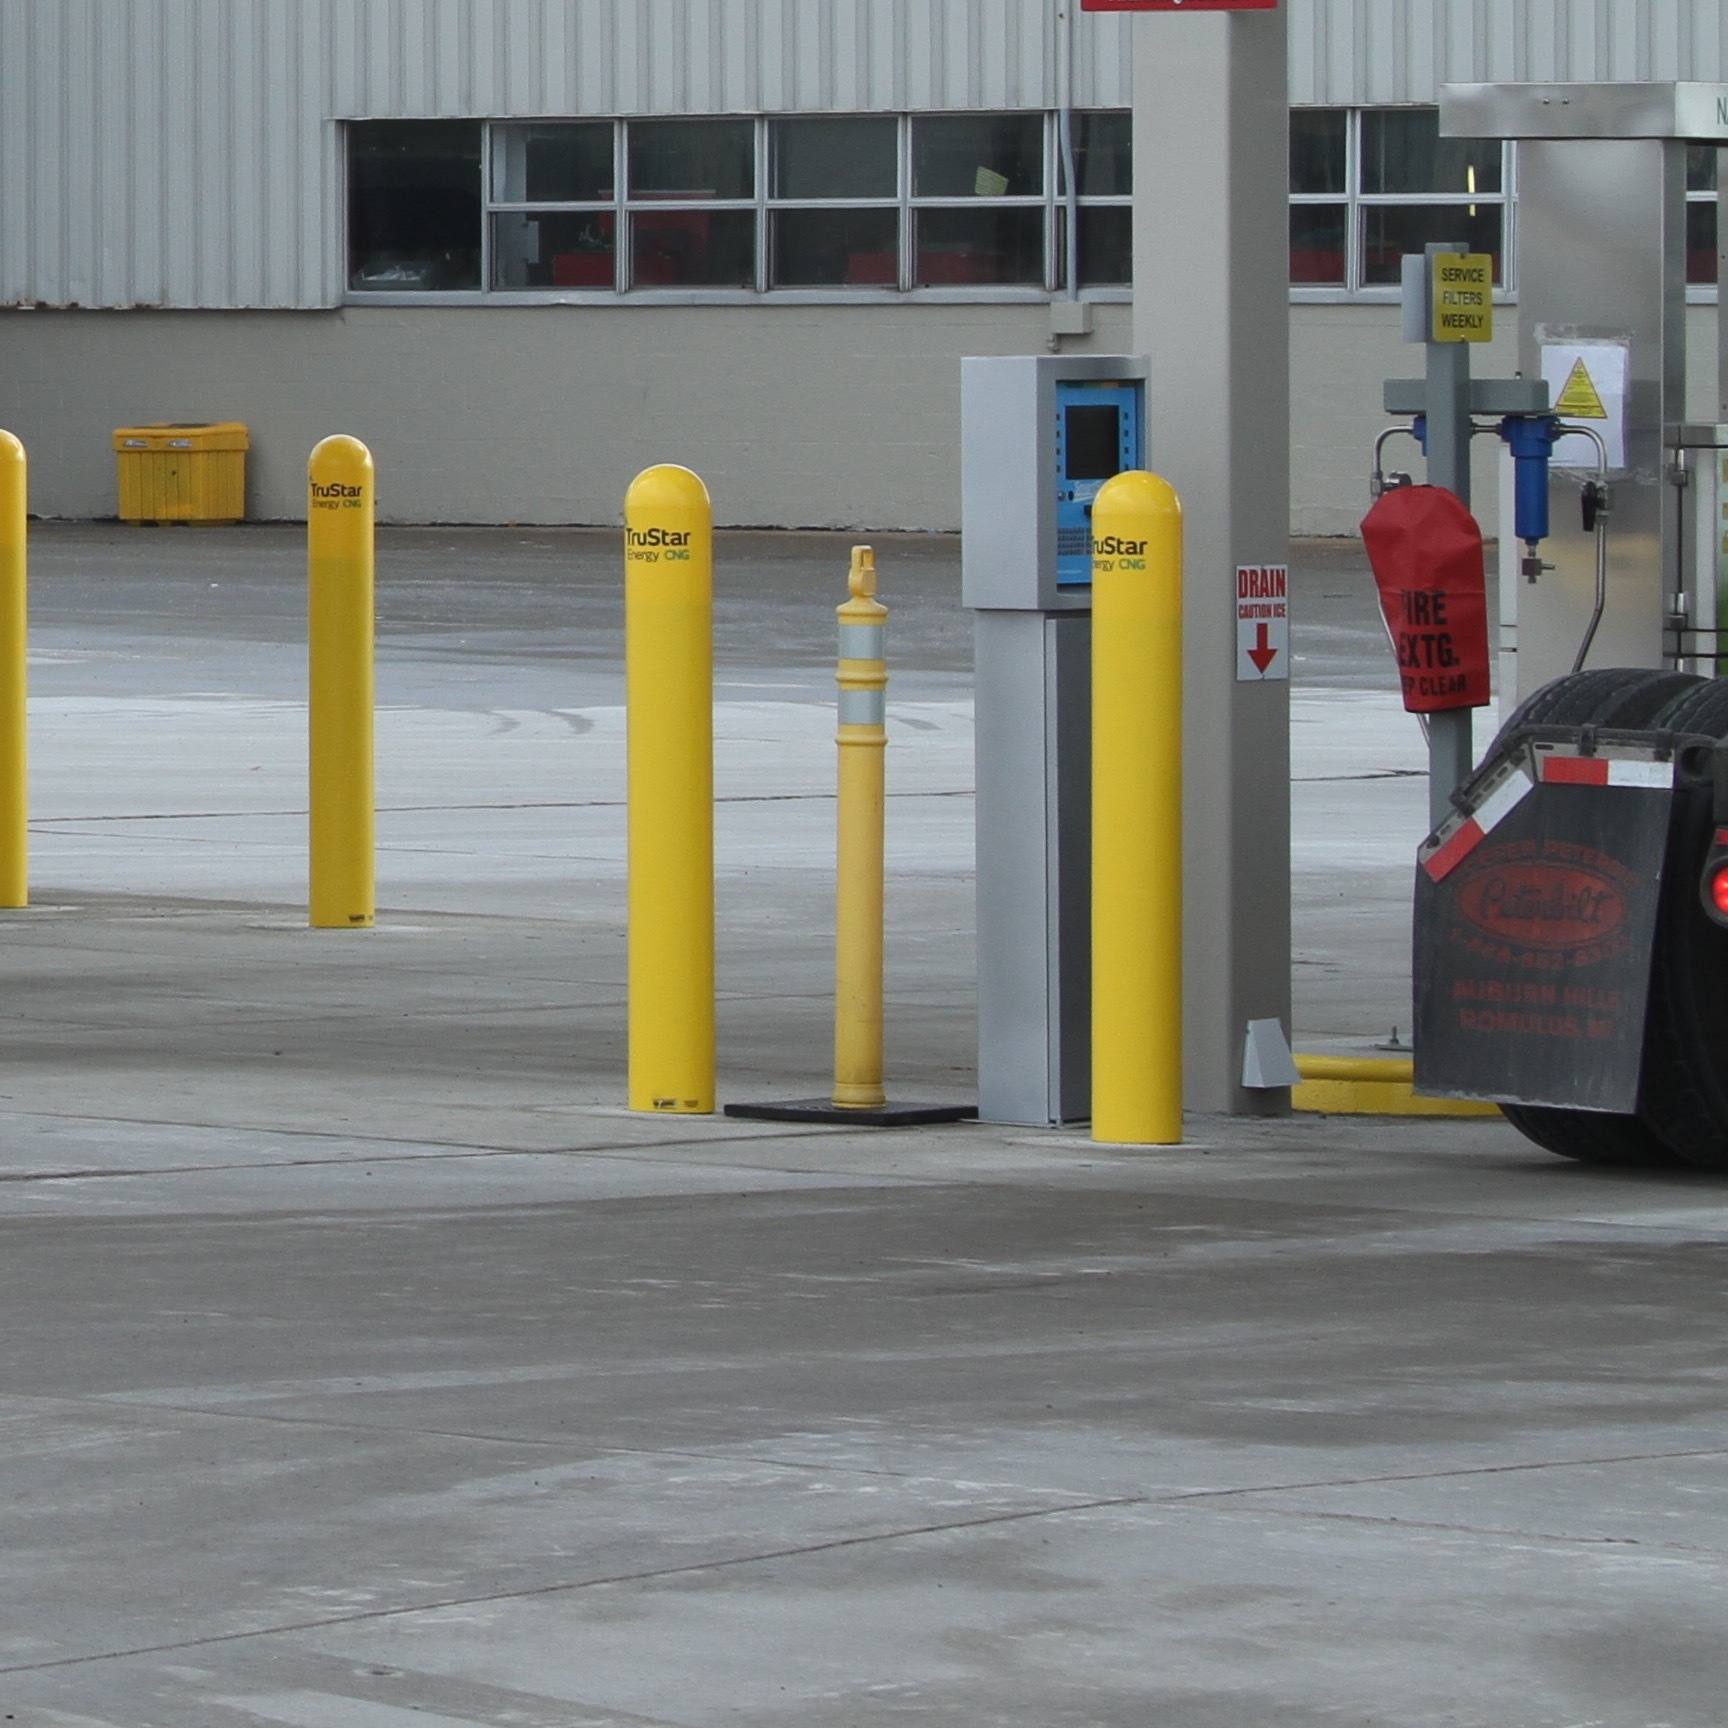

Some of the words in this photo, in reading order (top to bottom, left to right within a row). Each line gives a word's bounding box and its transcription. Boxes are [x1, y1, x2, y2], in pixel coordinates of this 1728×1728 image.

[1441, 267, 1484, 282] SERVICE
[1443, 290, 1482, 305] FILTERS
[1441, 313, 1484, 328] WEEKLY
[311, 482, 362, 497] TruStar
[312, 498, 339, 510] Energy
[343, 499, 362, 508] CNG
[626, 528, 691, 546] TruStar
[627, 549, 660, 563] Energy
[665, 549, 690, 560] CNG
[1119, 559, 1146, 570] CNG
[1238, 568, 1286, 599] DRAIN
[1239, 604, 1272, 619] CAUTION
[1274, 603, 1286, 618] ICE
[1419, 673, 1467, 697] CLEAR
[1479, 877, 1616, 923] Peterbilt
[1453, 979, 1556, 1004] AUBURN
